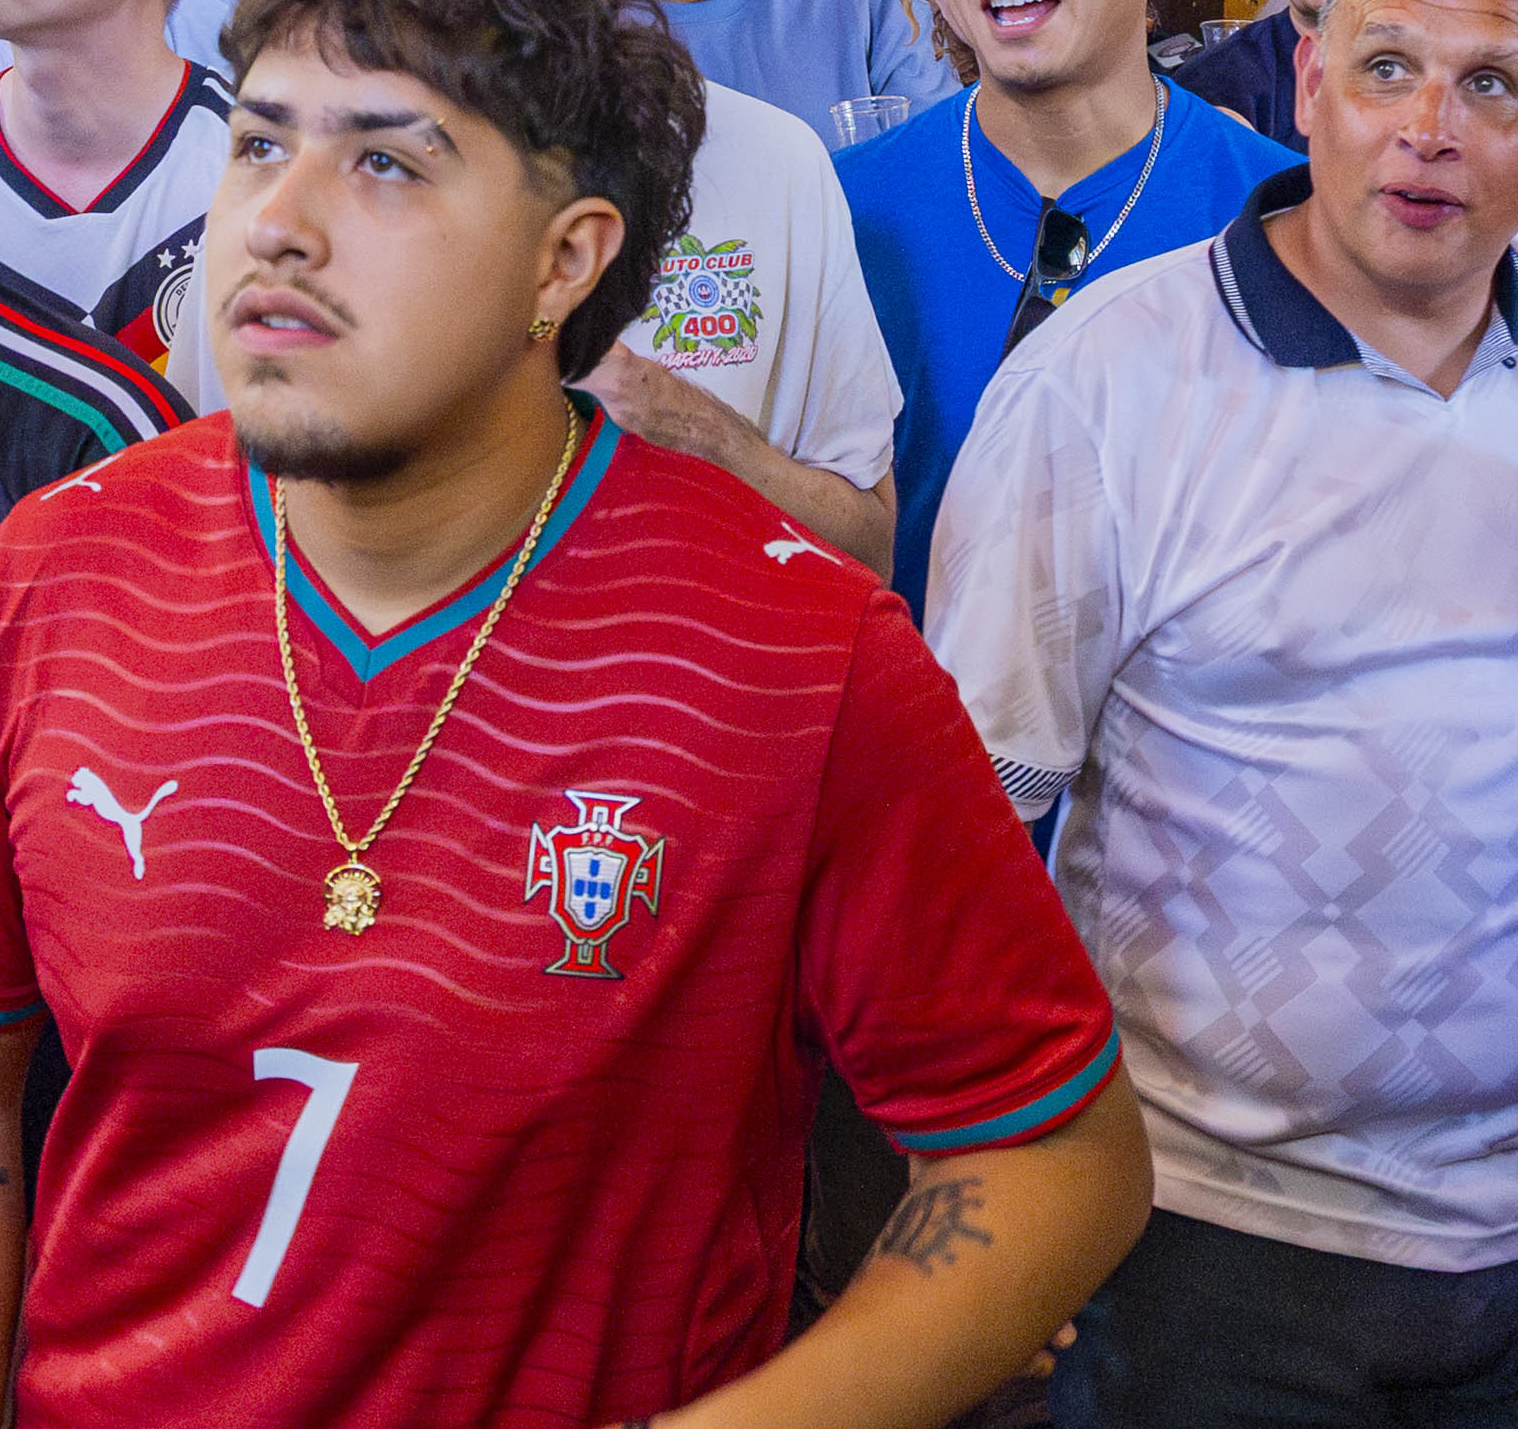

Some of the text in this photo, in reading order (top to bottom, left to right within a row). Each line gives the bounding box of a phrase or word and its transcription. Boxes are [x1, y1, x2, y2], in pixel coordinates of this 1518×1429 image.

[663, 253, 753, 272] UTO CLUB
[684, 314, 737, 337] 400
[231, 1047, 360, 1308] 7
